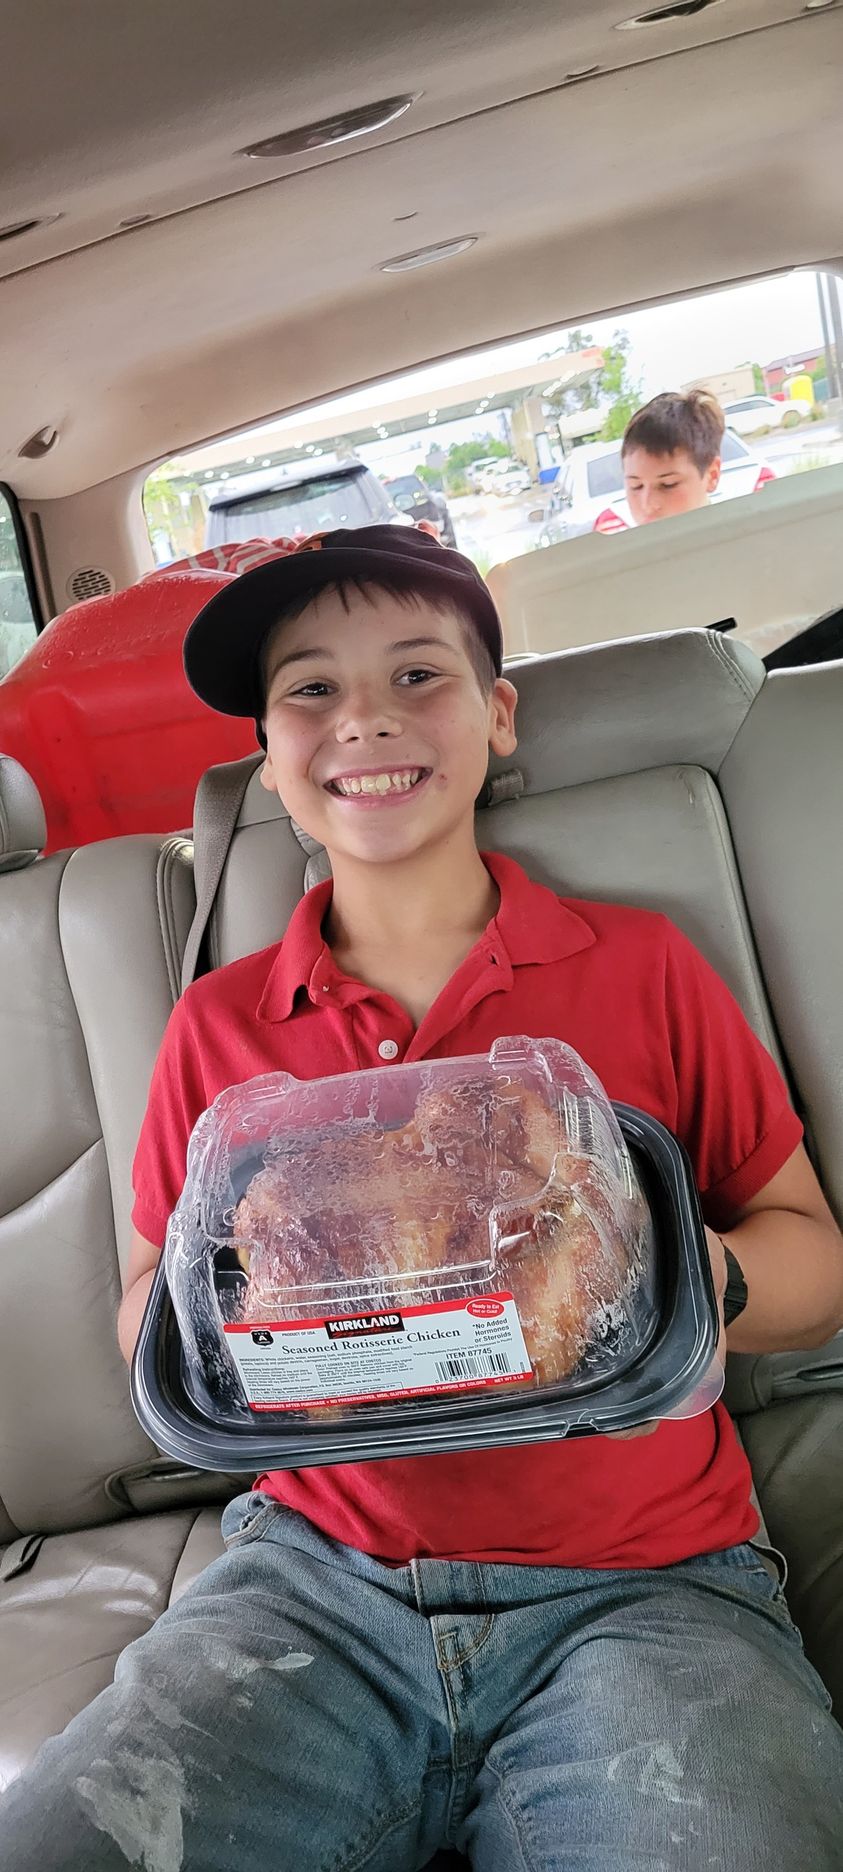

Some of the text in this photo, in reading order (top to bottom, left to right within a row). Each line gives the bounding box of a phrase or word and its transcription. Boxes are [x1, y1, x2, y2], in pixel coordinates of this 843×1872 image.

[329, 1315, 400, 1332] KIRKLAND
[487, 1318, 507, 1327] Added
[333, 1326, 400, 1338] Signature
[475, 1326, 510, 1336] Hormones
[484, 1332, 511, 1341] Steroids
[282, 1329, 461, 1355] Seasoned Rotisserie Chicken
[446, 1348, 492, 1360] ITEM 87745
